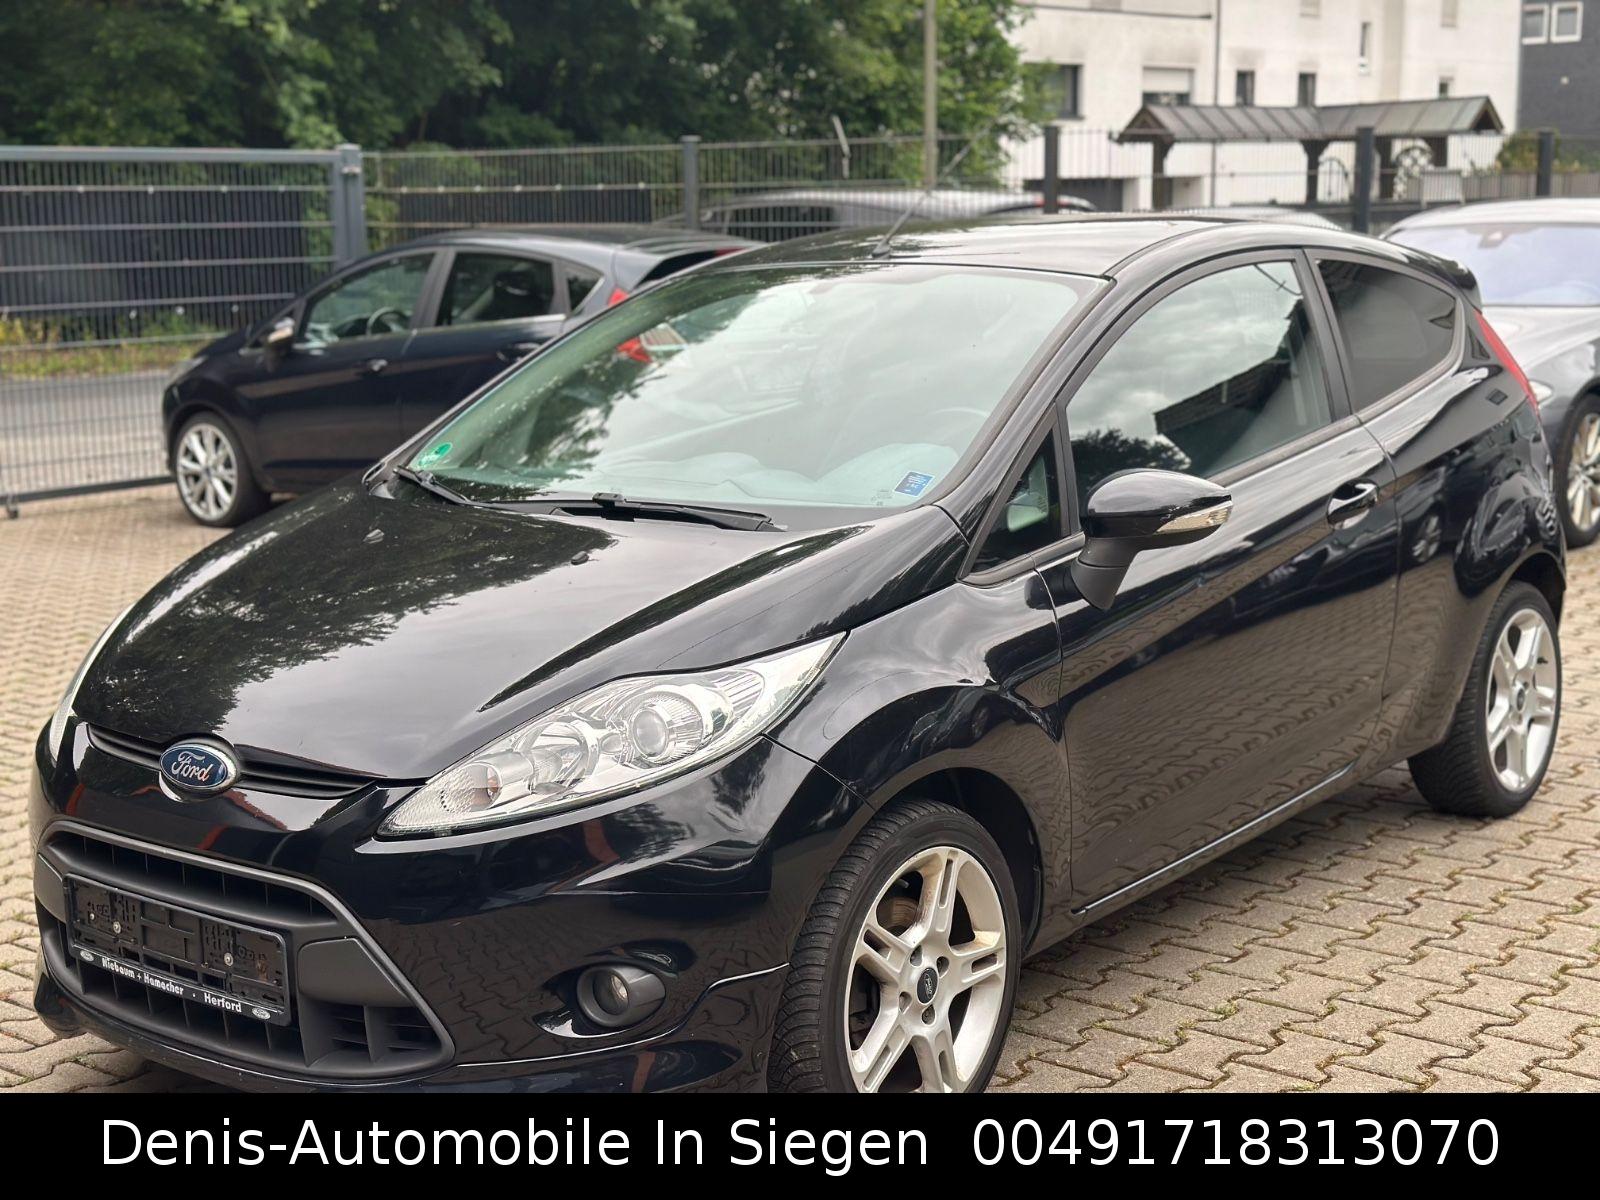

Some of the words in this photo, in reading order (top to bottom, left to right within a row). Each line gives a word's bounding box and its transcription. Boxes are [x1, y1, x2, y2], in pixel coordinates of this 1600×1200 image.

[171, 751, 214, 782] Ford
[101, 956, 136, 979] Niebaum
[144, 973, 185, 995] Hamacher
[204, 992, 243, 1013] Herford
